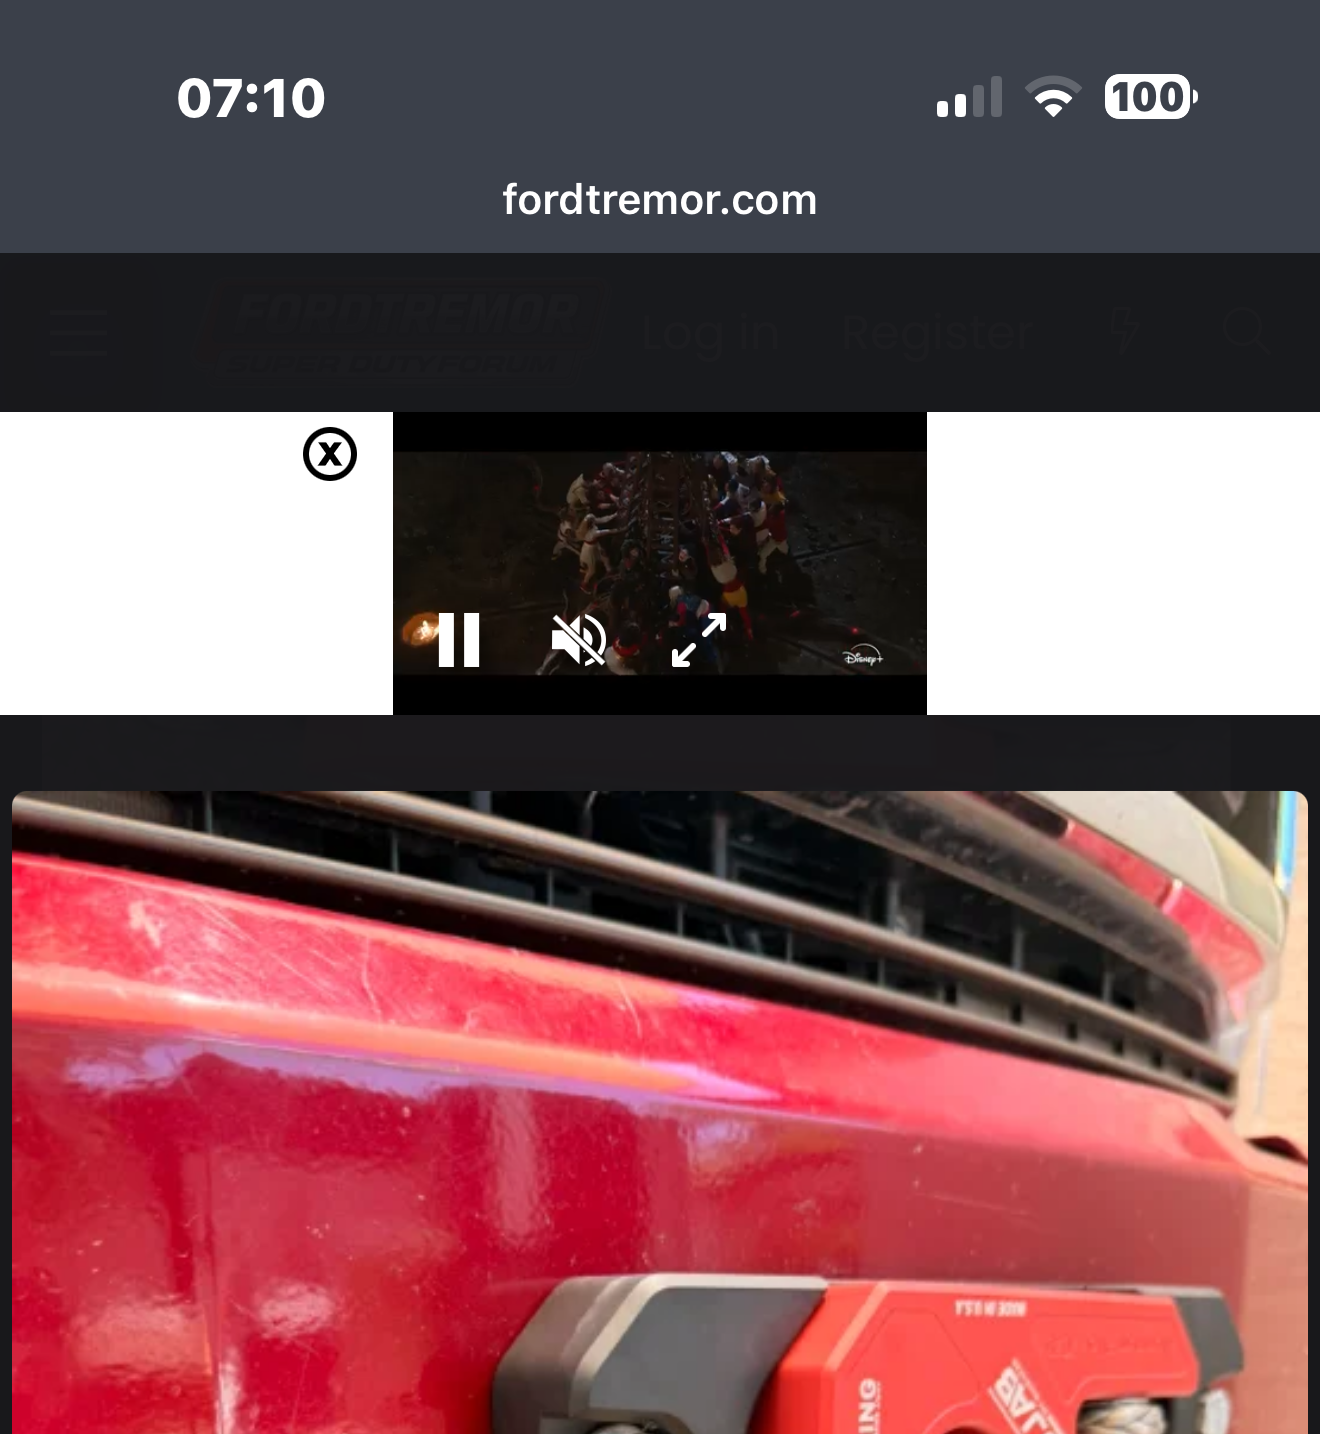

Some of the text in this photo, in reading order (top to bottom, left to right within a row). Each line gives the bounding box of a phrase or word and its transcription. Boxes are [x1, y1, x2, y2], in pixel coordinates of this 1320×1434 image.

[177, 77, 325, 119] 07:10
[1112, 80, 1184, 113] 100
[502, 182, 817, 216] fordtremor.com
[233, 293, 580, 335] FORDTREMOR
[643, 311, 779, 363] Log in
[843, 311, 1034, 363] Register
[226, 354, 341, 374] SUPER
